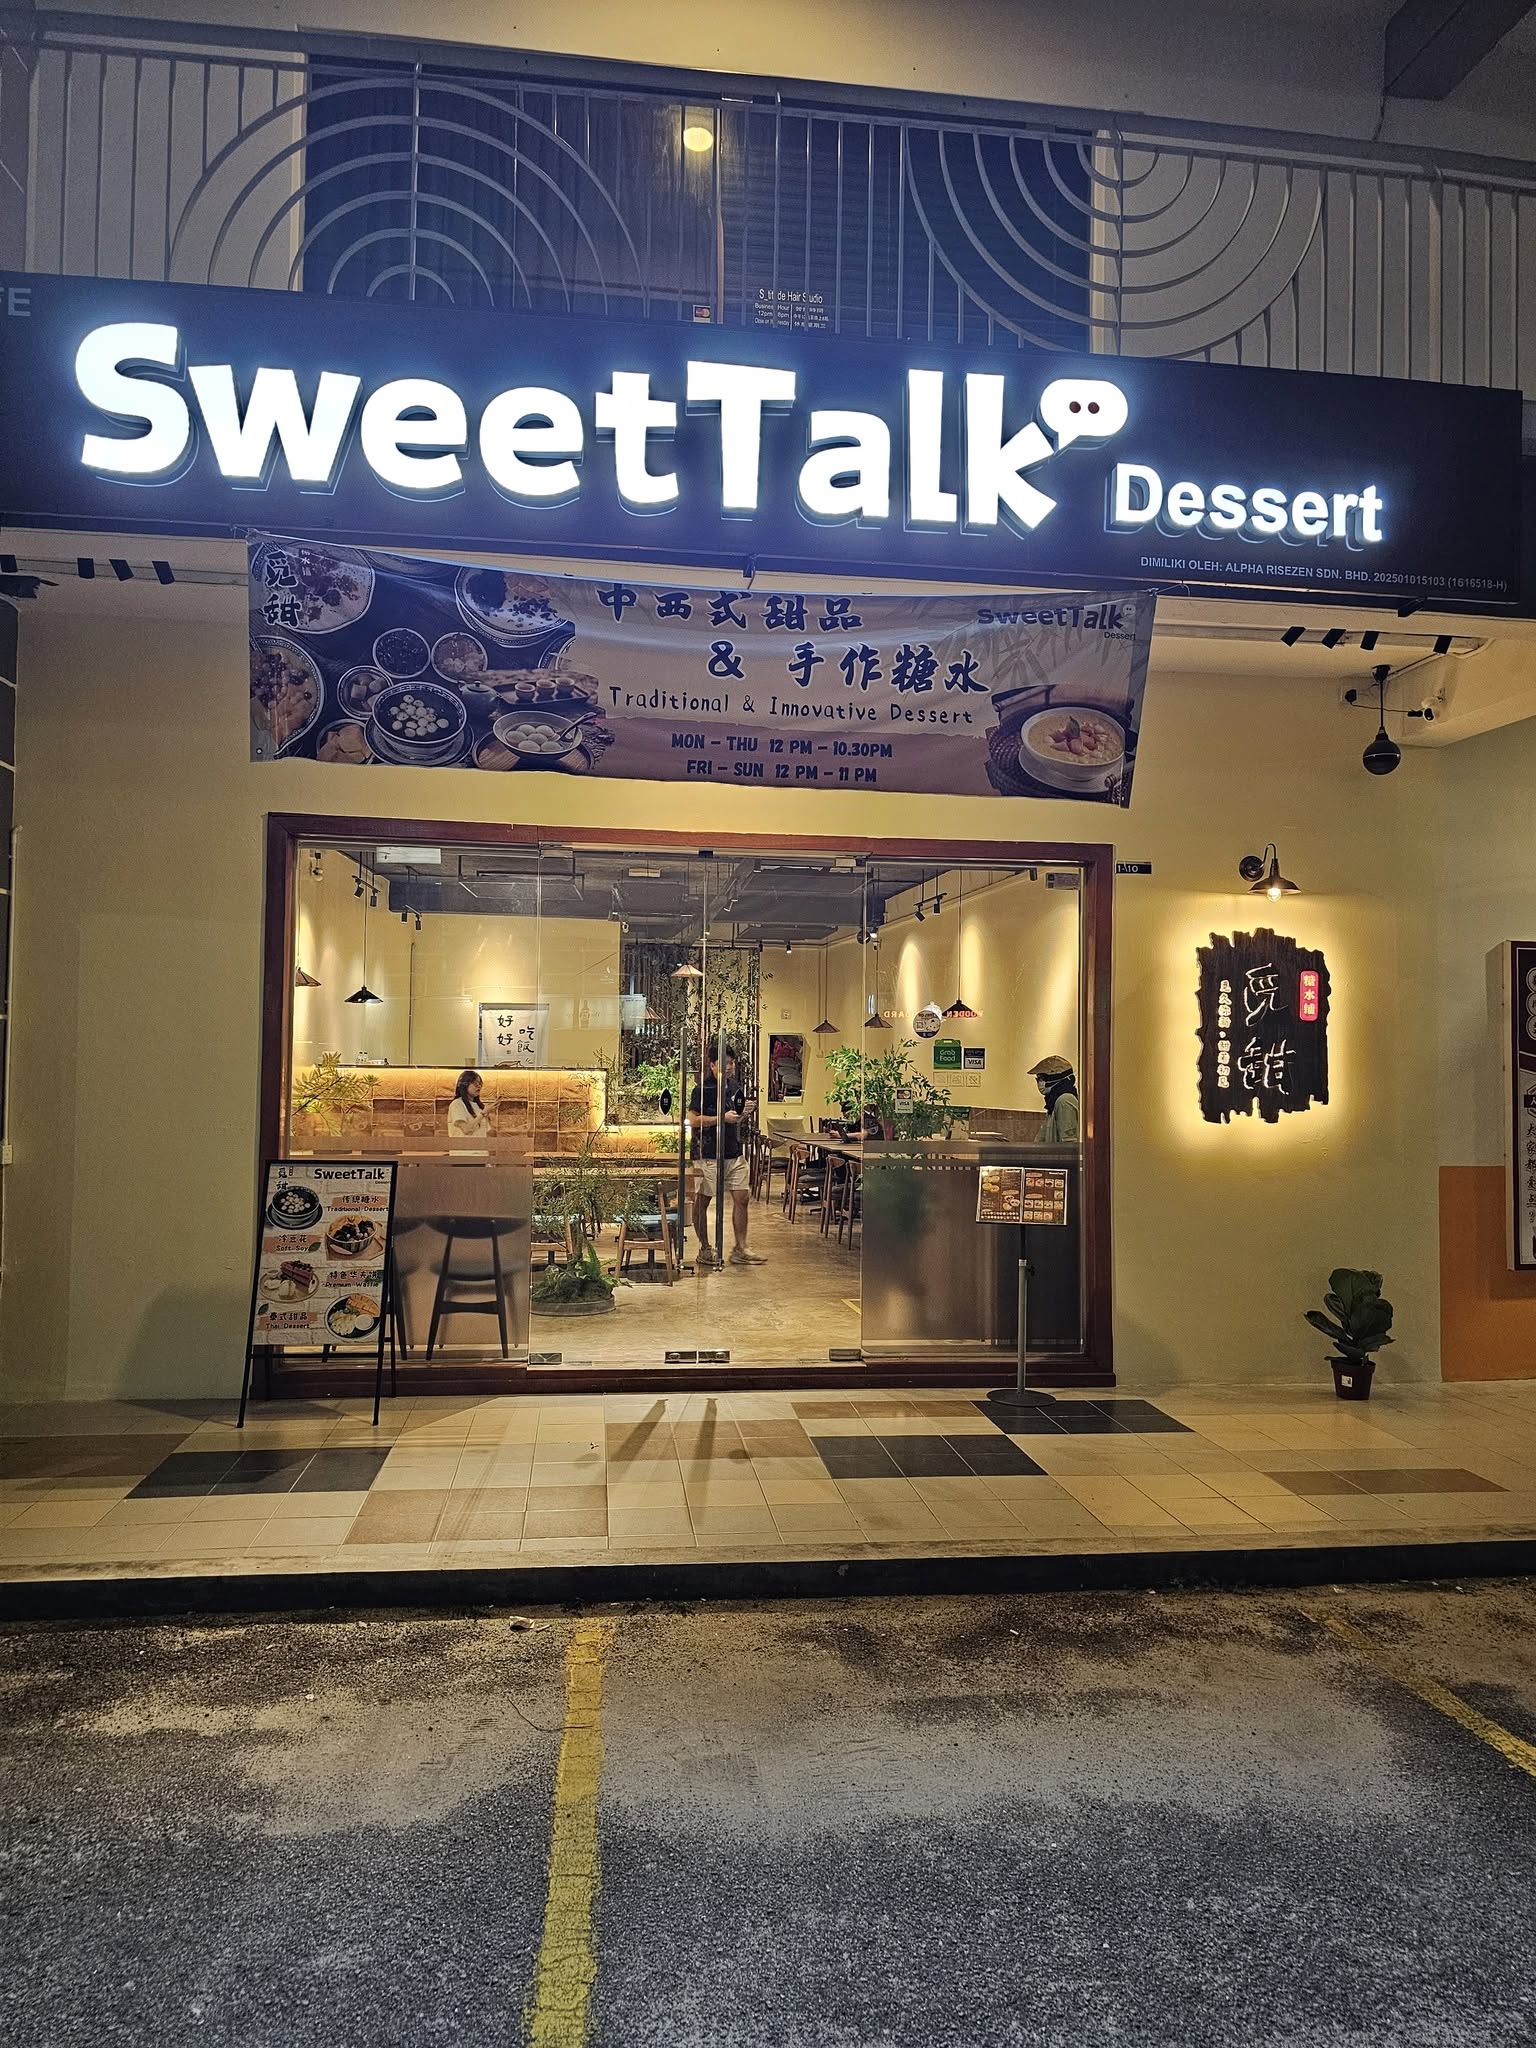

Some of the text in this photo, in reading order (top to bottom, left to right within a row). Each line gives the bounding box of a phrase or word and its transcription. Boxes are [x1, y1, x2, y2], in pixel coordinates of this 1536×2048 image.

[0, 287, 31, 317] E
[787, 291, 801, 302] Hair
[802, 292, 823, 304] Sudio
[74, 321, 1057, 530] SweetTalk
[1114, 462, 1384, 543] Dessert
[1140, 556, 1508, 592] DIMILIKI OLEH: ALPHA RISEZEN SDN. BHD. 202501015103 (1616518-H)
[596, 583, 863, 632] 中西式甜品
[977, 604, 1124, 631] SweetTalk
[708, 640, 991, 696] & 手作糖水
[608, 686, 973, 725] Traditional & Innovative Dessert
[671, 733, 705, 749] MON
[726, 735, 758, 751] THU
[769, 738, 783, 753] 12
[789, 739, 813, 755] PM
[833, 741, 893, 758] 10.30PM
[686, 759, 712, 775] FRI
[733, 762, 764, 777] SUN
[775, 764, 789, 778] 12
[795, 765, 818, 780] PM
[839, 767, 849, 781] 11
[855, 768, 877, 783] PM
[496, 1014, 514, 1046] 好好
[939, 1048, 956, 1056] Grab
[967, 1058, 983, 1066] VISA
[313, 1167, 385, 1180] SweetTalk
[275, 1244, 291, 1252] Soft
